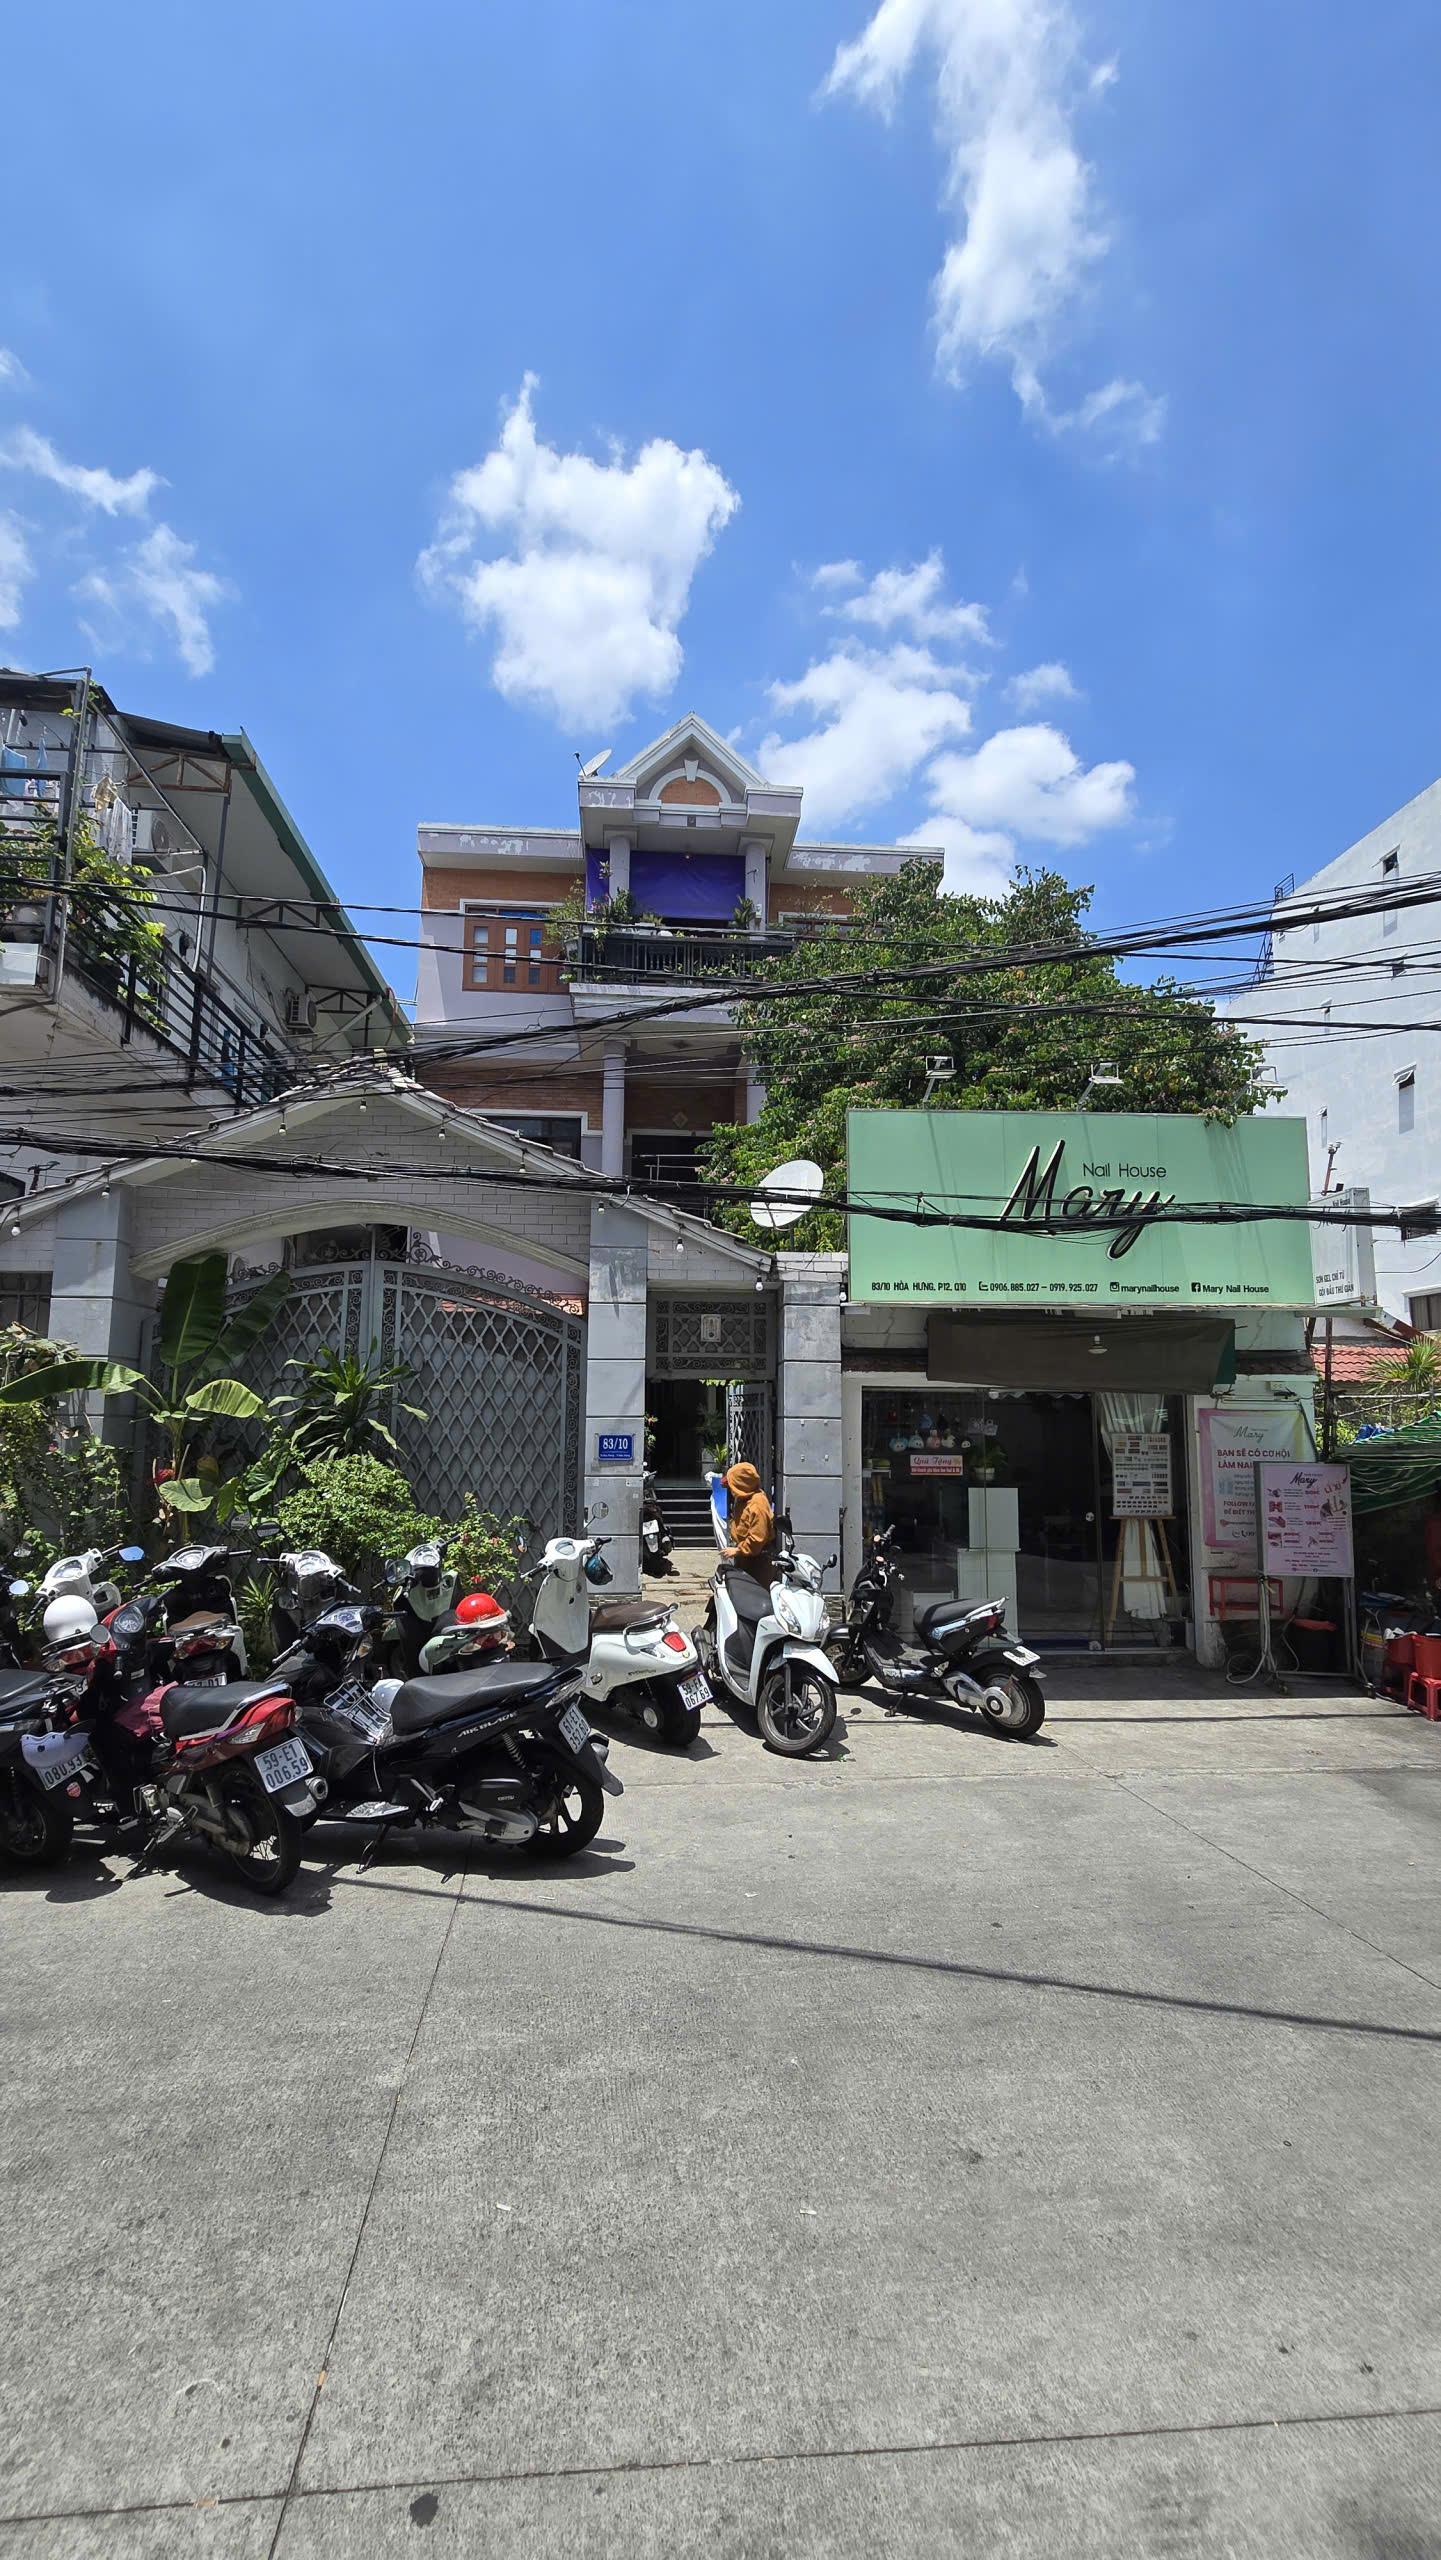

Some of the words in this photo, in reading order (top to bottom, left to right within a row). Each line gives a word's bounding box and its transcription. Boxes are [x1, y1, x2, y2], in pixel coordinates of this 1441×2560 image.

[1083, 1162, 1110, 1177] Nail
[1119, 1163, 1167, 1178] House
[1000, 1139, 1176, 1260] Mary
[893, 1280, 909, 1291] HÒA
[990, 1282, 1040, 1292] 0906.885.027
[1050, 1283, 1098, 1292] 0919.925.027
[1121, 1283, 1180, 1294] marynailhouse
[1202, 1284, 1224, 1294] Mary
[1226, 1284, 1241, 1293] Nail
[1243, 1284, 1270, 1293] House
[1233, 1425, 1265, 1443] Mary
[602, 1437, 629, 1450] 83/10
[1248, 1448, 1261, 1457] CÓ
[1218, 1459, 1236, 1469] LÀM
[1237, 1461, 1253, 1469] NAI
[1289, 1472, 1318, 1488] Mary
[681, 1675, 704, 1695] 59-FA
[685, 1687, 710, 1708] 067.69
[262, 1743, 298, 1771] 59-E1
[265, 1757, 309, 1788] 006.59
